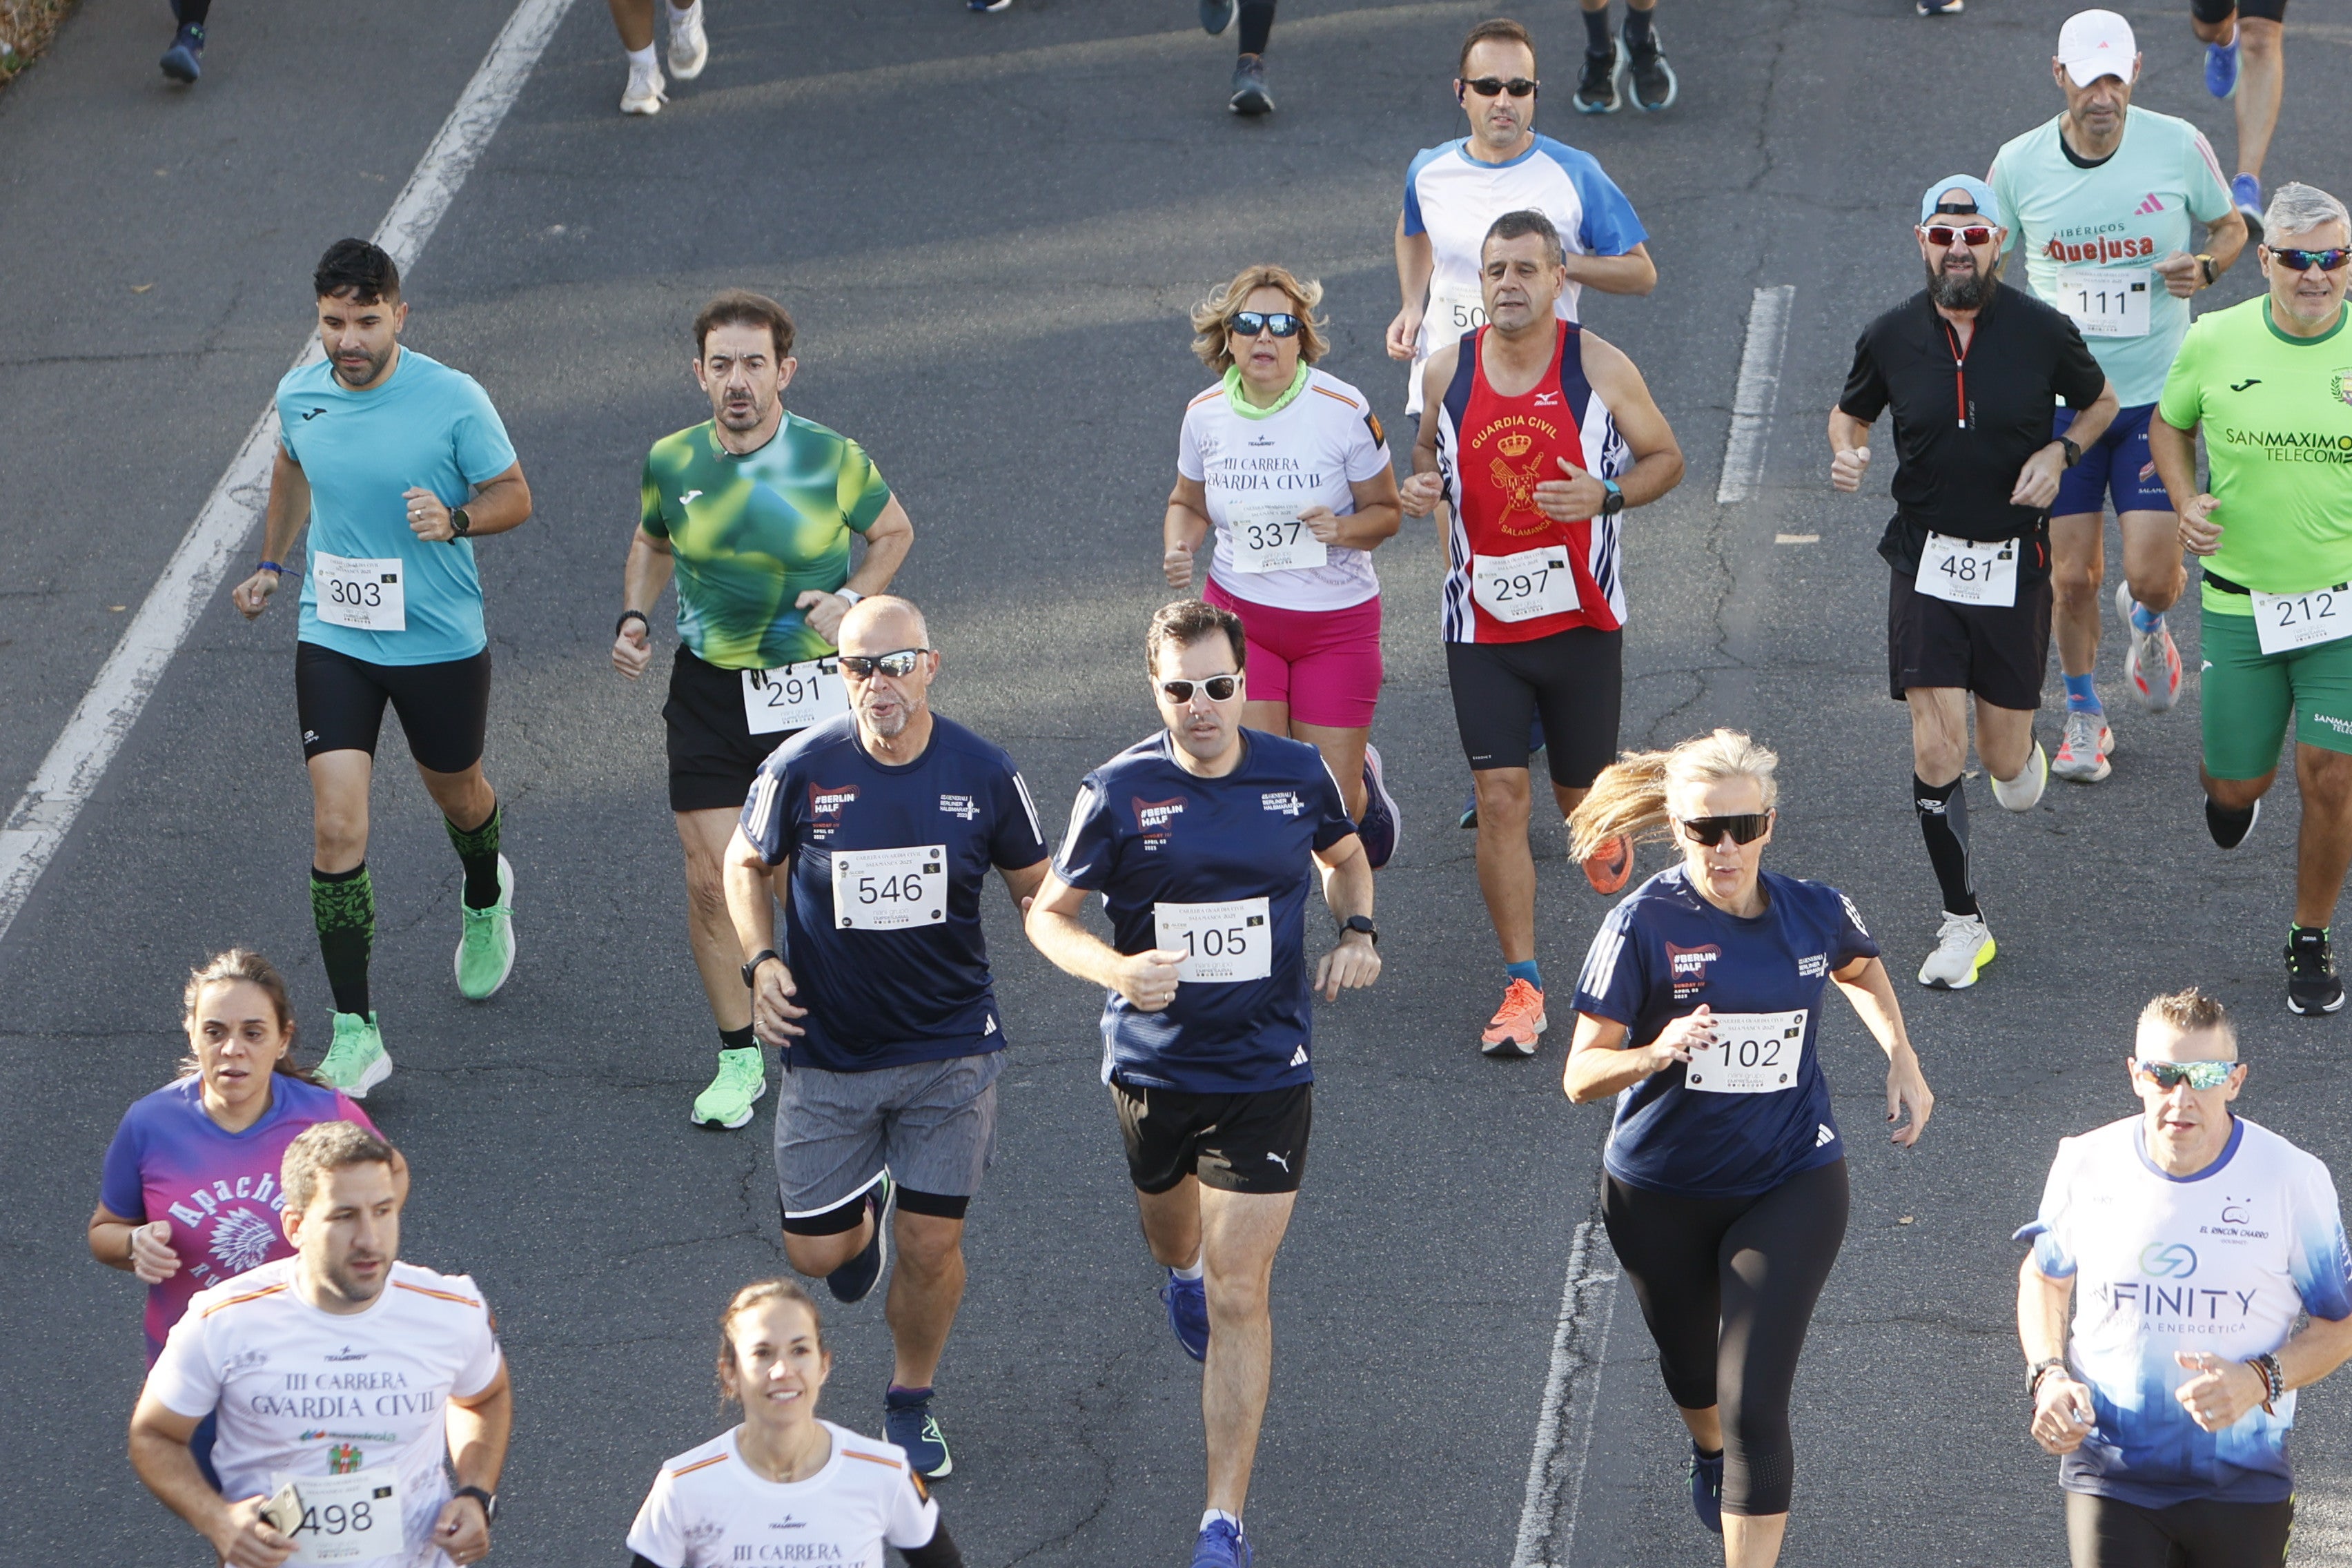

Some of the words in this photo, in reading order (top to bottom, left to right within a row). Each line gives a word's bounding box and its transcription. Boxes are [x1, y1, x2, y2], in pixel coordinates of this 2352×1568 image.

[2060, 223, 2125, 237] IBÉRICOS
[2050, 235, 2154, 264] Quejusa
[2078, 290, 2124, 314] 111
[1472, 415, 1525, 449] GUARDIA
[1528, 416, 1558, 440] CIVIL
[2226, 428, 2352, 451] SANMAXIMO
[1224, 458, 1237, 470] III
[1242, 458, 1300, 471] CARRERA
[1277, 473, 1323, 490] CIVIL
[1248, 522, 1301, 550] 337
[1501, 518, 1552, 537] SALAMANCA
[1940, 555, 1992, 581] 481
[331, 580, 381, 607] 303
[1493, 569, 1549, 601] 297
[2277, 593, 2335, 627] 212
[767, 676, 819, 707] 291
[815, 794, 854, 804] #BERLIN
[815, 803, 839, 813] HALF
[1141, 805, 1183, 819] #BERLIN
[1141, 815, 1168, 827] HALF
[859, 874, 923, 904] 546
[1182, 928, 1246, 957] 105
[1674, 953, 1716, 963] #BERLIN
[1675, 963, 1701, 972] HALF
[1718, 1039, 1781, 1067] 102
[168, 1173, 287, 1228] Apache
[2158, 1322, 2246, 1333] ENERGÉTICA
[286, 1373, 307, 1391] III
[315, 1371, 408, 1391] CARRERA
[376, 1391, 435, 1415] CIVIL
[302, 1501, 372, 1535] 498
[733, 1545, 752, 1561] III
[759, 1543, 841, 1561] CARRERA
